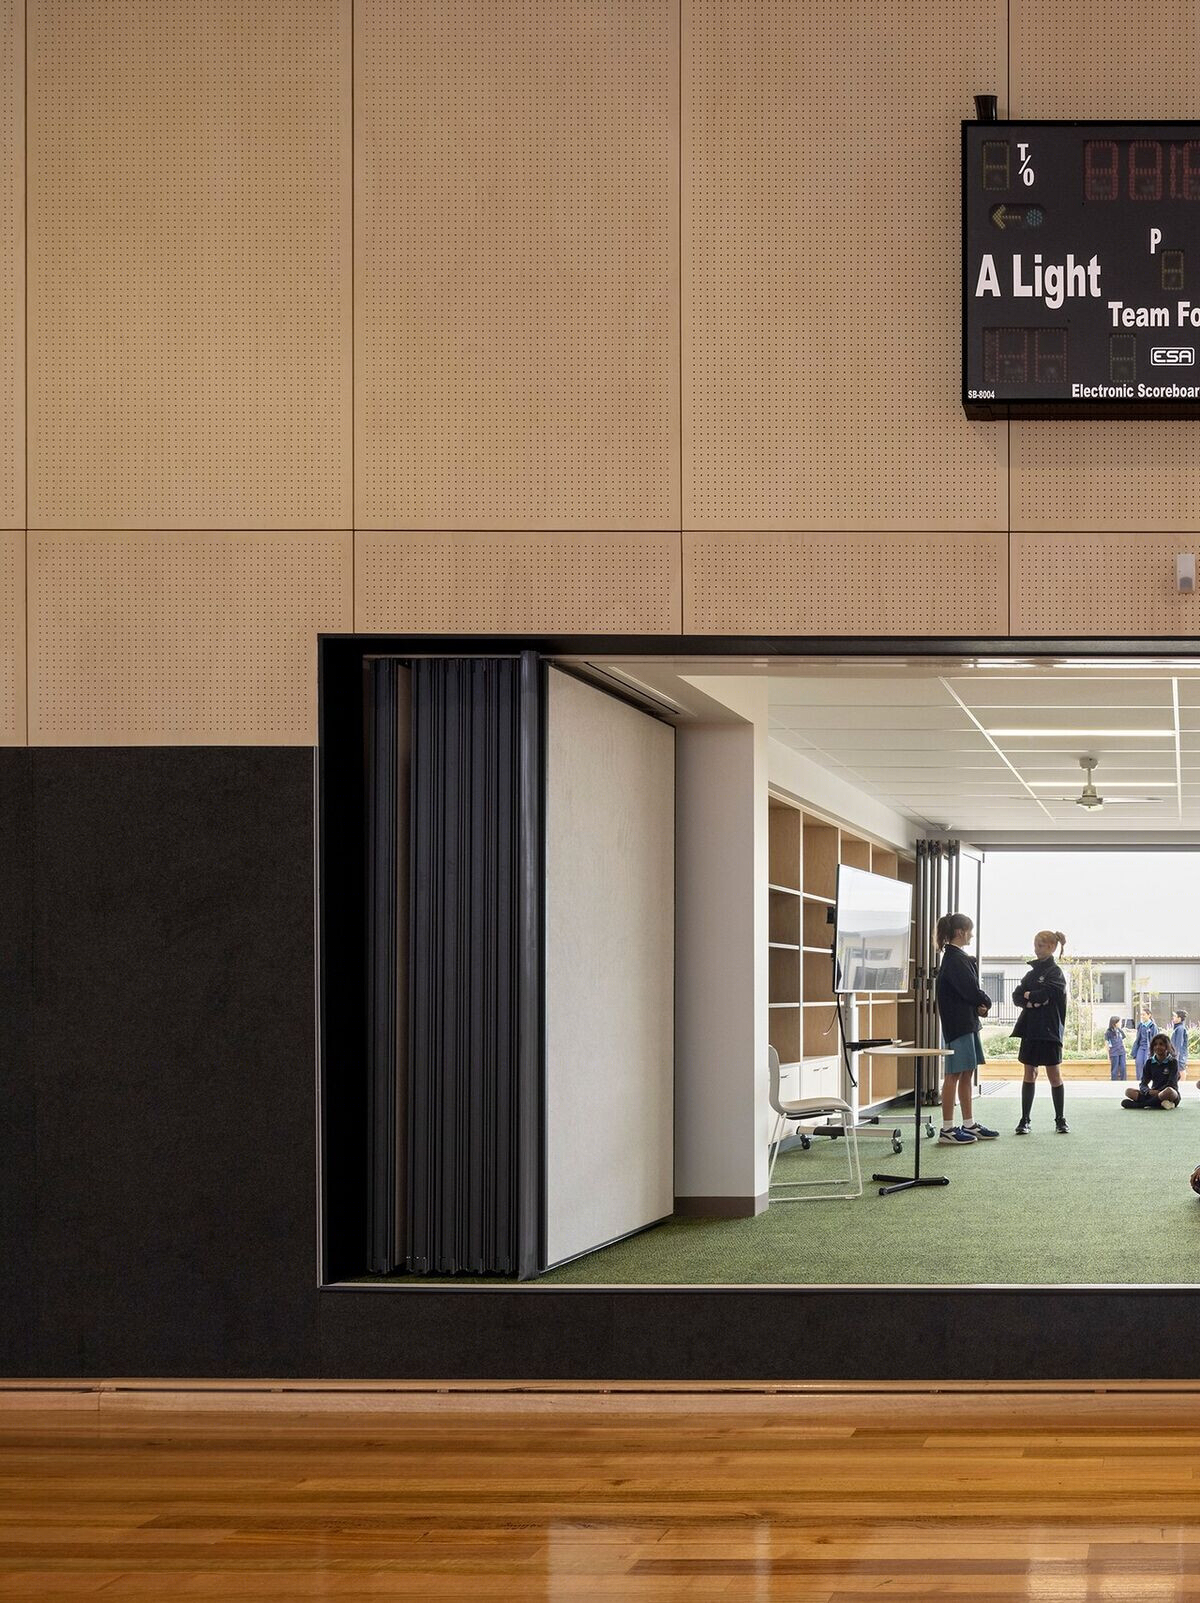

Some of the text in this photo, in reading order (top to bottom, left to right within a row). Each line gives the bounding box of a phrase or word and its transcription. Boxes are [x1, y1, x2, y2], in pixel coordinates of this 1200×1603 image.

[1150, 228, 1162, 255] P
[975, 254, 1101, 309] A Light
[1108, 301, 1170, 328] Team
[1153, 350, 1192, 363] ESA
[1072, 383, 1134, 398] Electronic
